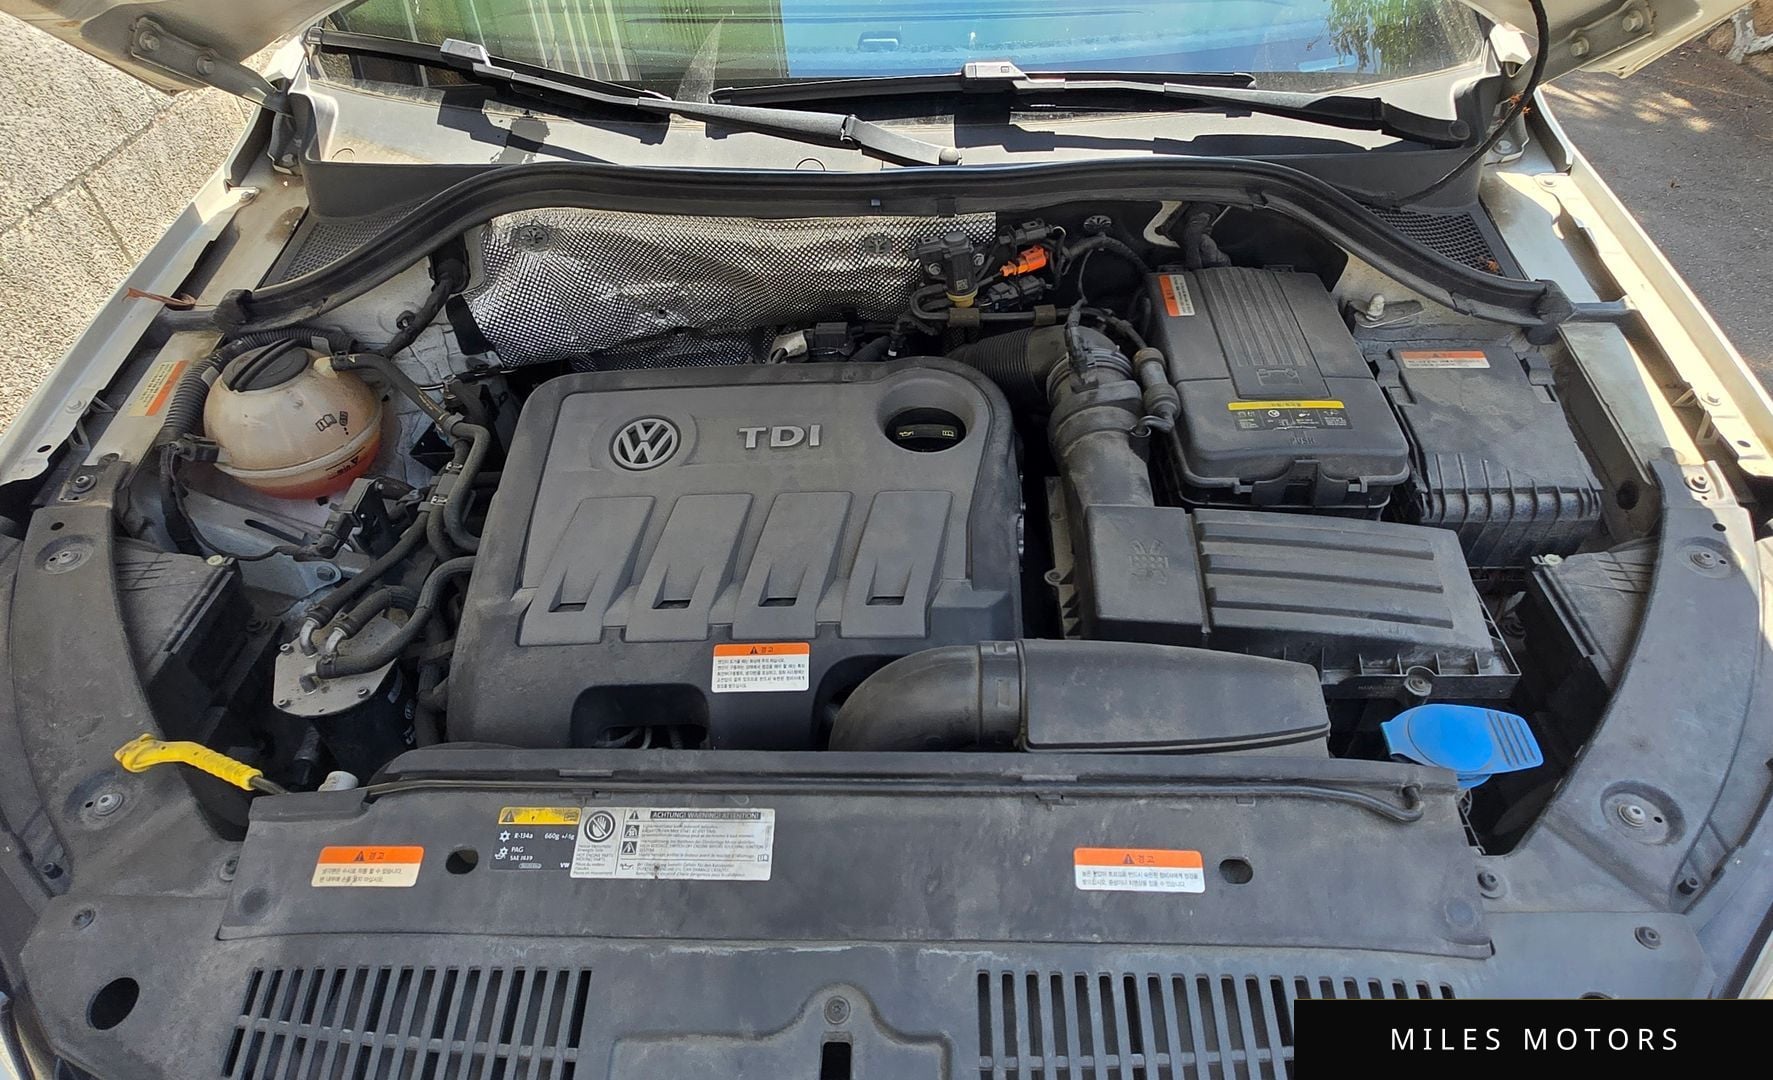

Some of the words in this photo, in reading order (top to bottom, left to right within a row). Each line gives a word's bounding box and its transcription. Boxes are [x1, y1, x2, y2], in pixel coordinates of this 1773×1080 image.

[737, 424, 822, 449] TDI
[652, 811, 686, 819] ACHTUNG!
[688, 811, 721, 819] WARNING!
[368, 851, 385, 860] 경고
[1137, 854, 1155, 864] 경고
